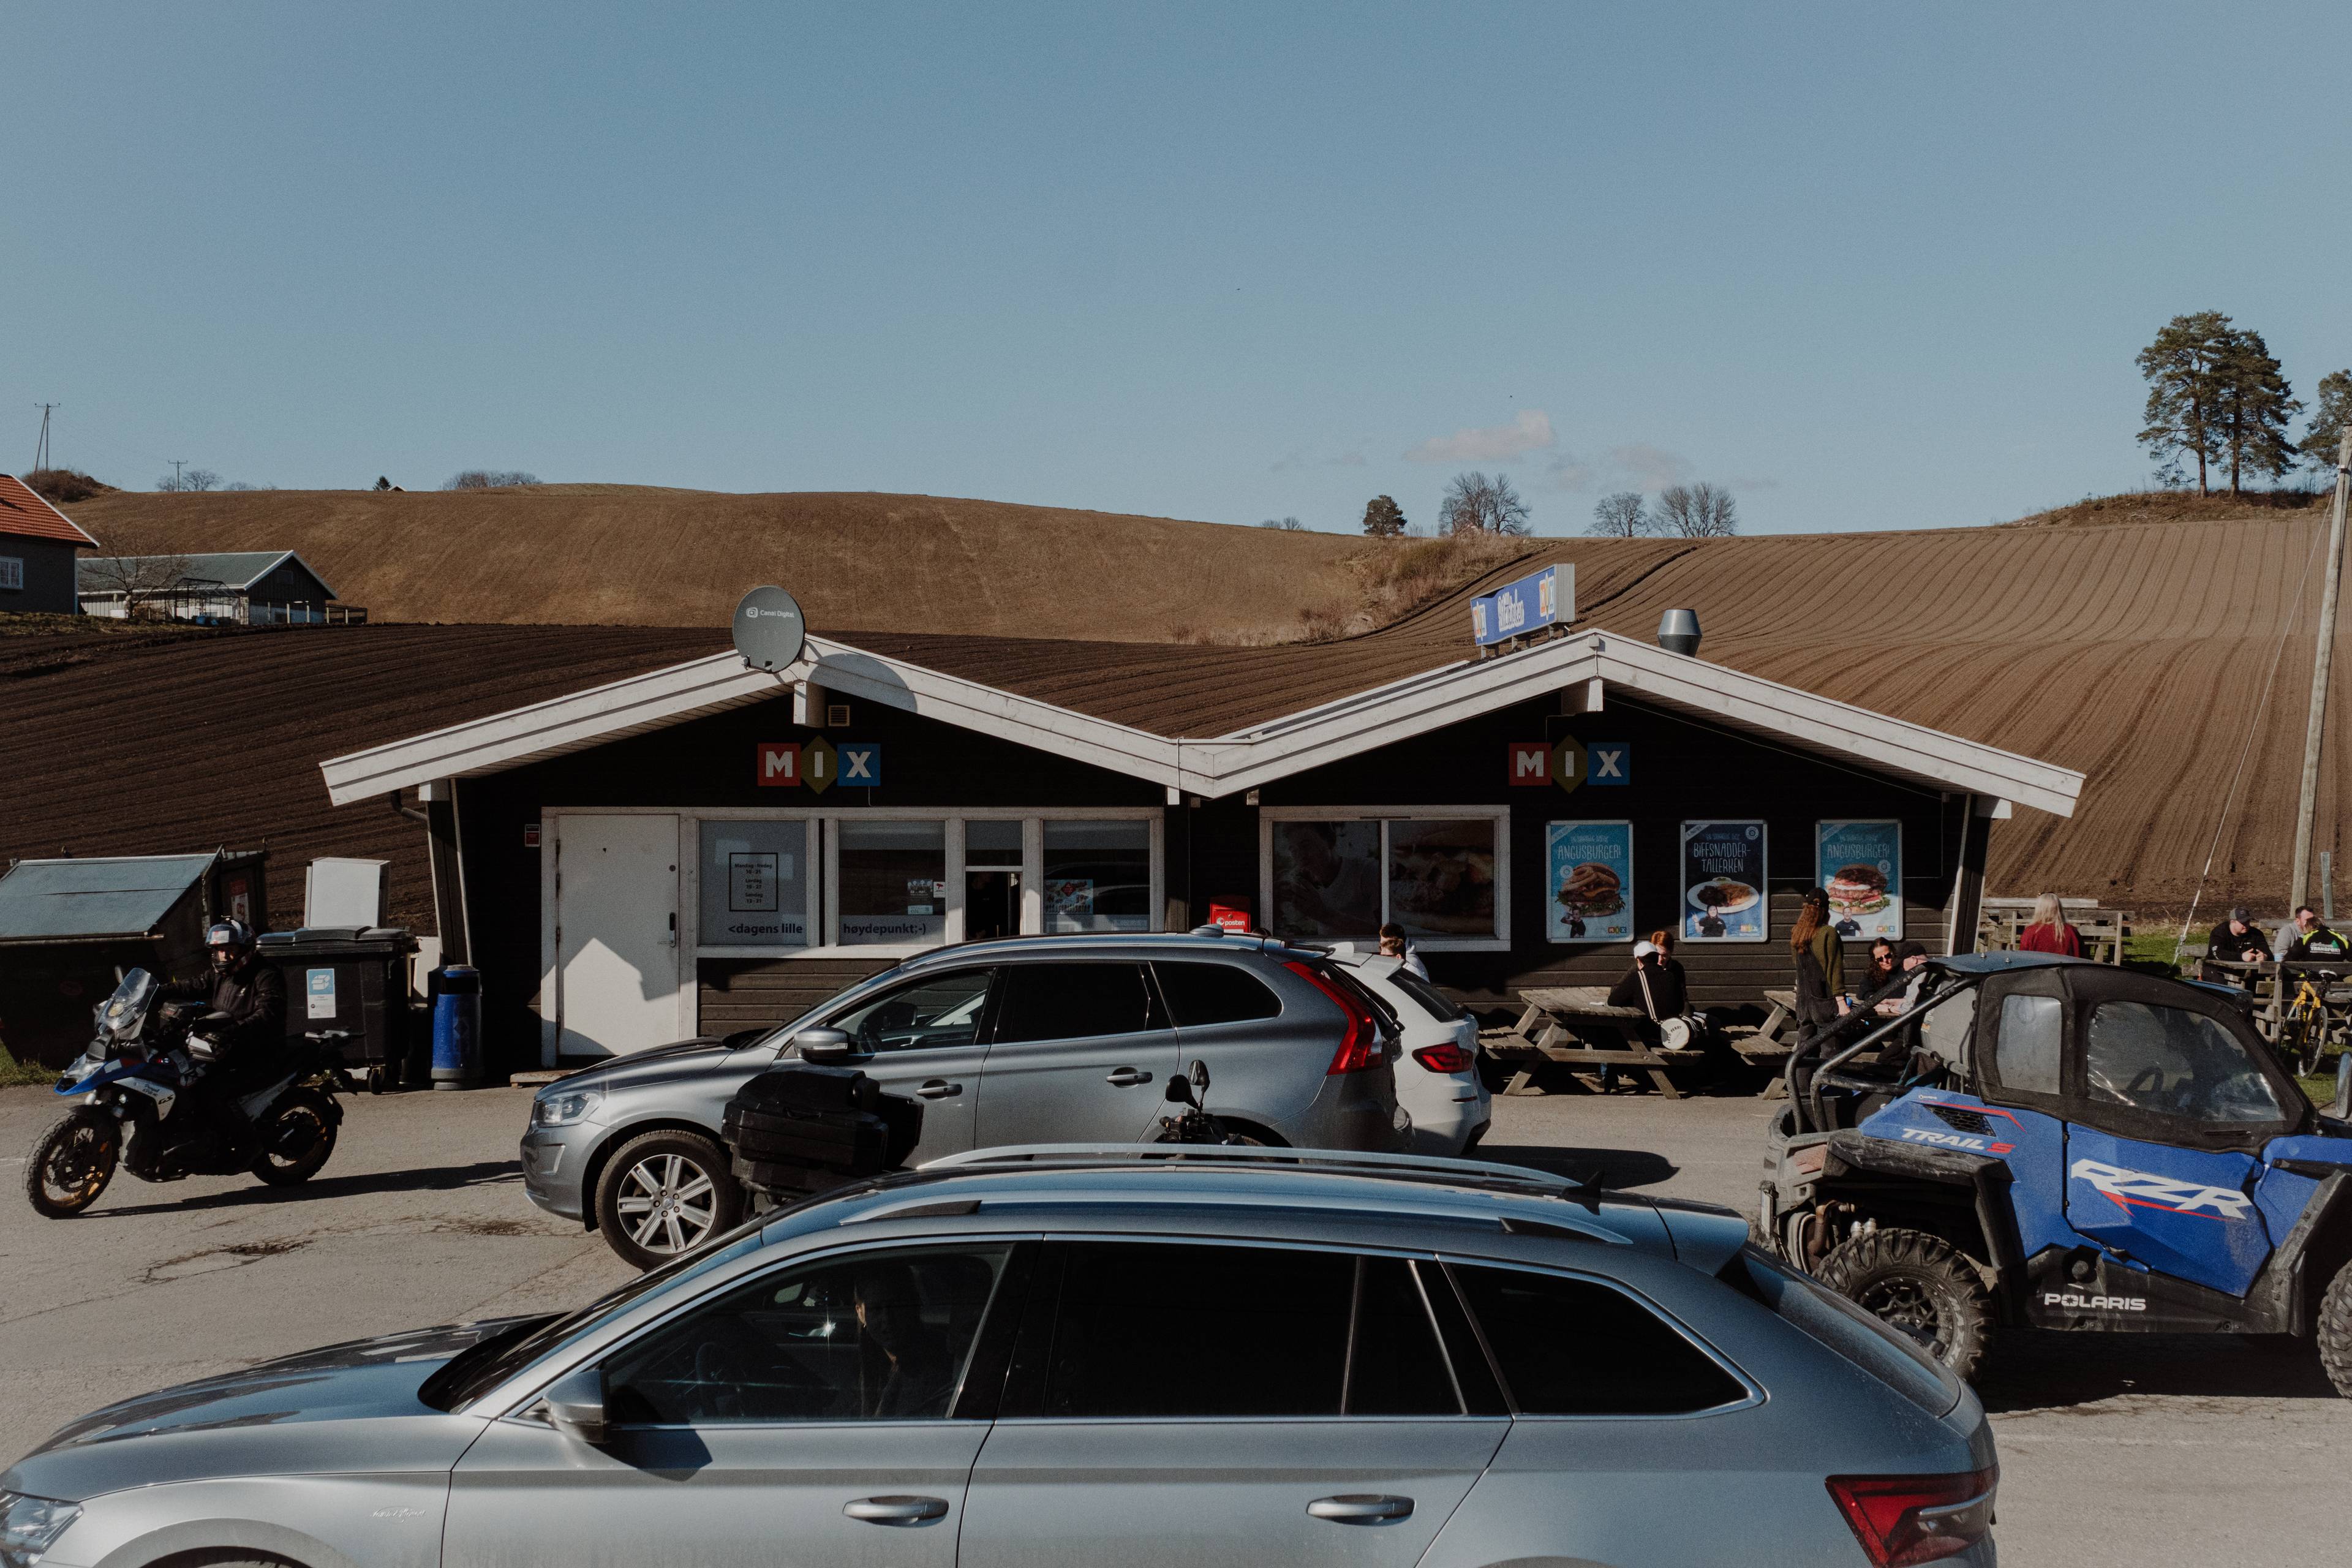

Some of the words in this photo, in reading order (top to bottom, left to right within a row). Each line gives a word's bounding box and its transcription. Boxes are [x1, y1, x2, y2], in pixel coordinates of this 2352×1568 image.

[765, 750, 872, 778] MIX
[1516, 750, 1623, 778] MIX
[1700, 858, 1744, 873] TALLERKEN
[728, 923, 778, 936] <dagens
[781, 923, 803, 933] lille
[1901, 1128, 1985, 1150] TRAIL
[1986, 1142, 2016, 1154] S
[2070, 1158, 2253, 1220] RZR
[2043, 1292, 2147, 1311] POLARIS
